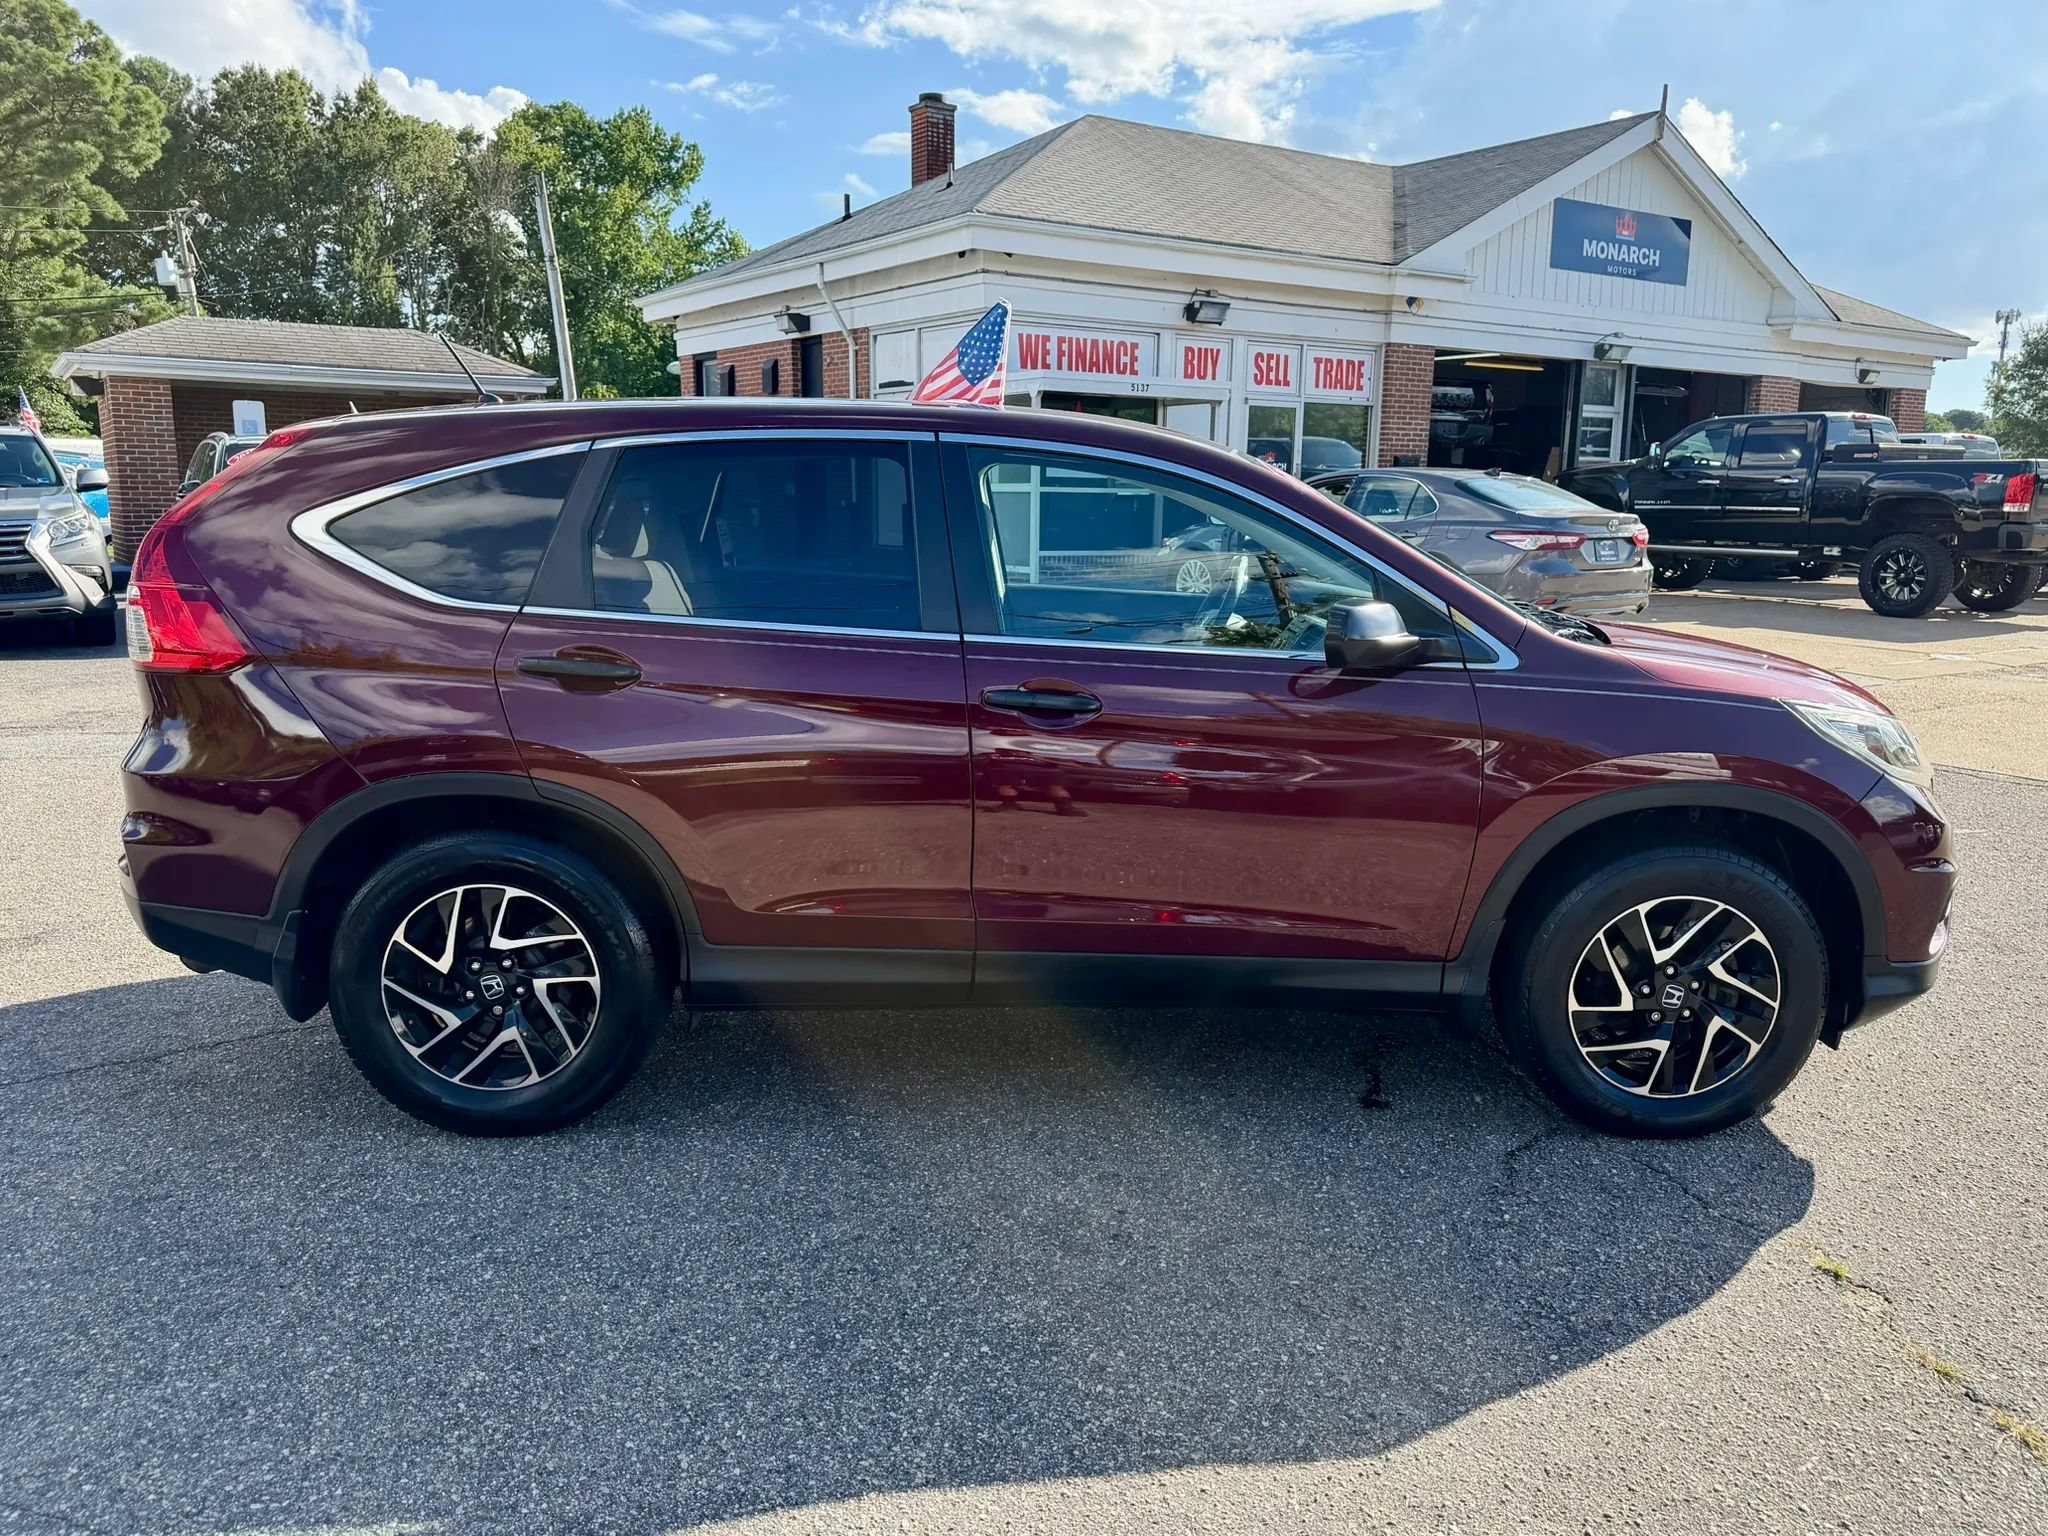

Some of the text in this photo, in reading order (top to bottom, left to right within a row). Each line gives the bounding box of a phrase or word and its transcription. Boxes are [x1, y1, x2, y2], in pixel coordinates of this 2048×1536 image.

[1583, 239, 1660, 266] MONARCH
[1607, 266, 1637, 276] MOTORS
[1018, 333, 1139, 376] WE FINANCE
[1184, 346, 1220, 381] BUY
[1253, 352, 1290, 387] SELL
[1131, 383, 1150, 392] 5137
[1313, 357, 1365, 391] TRADE
